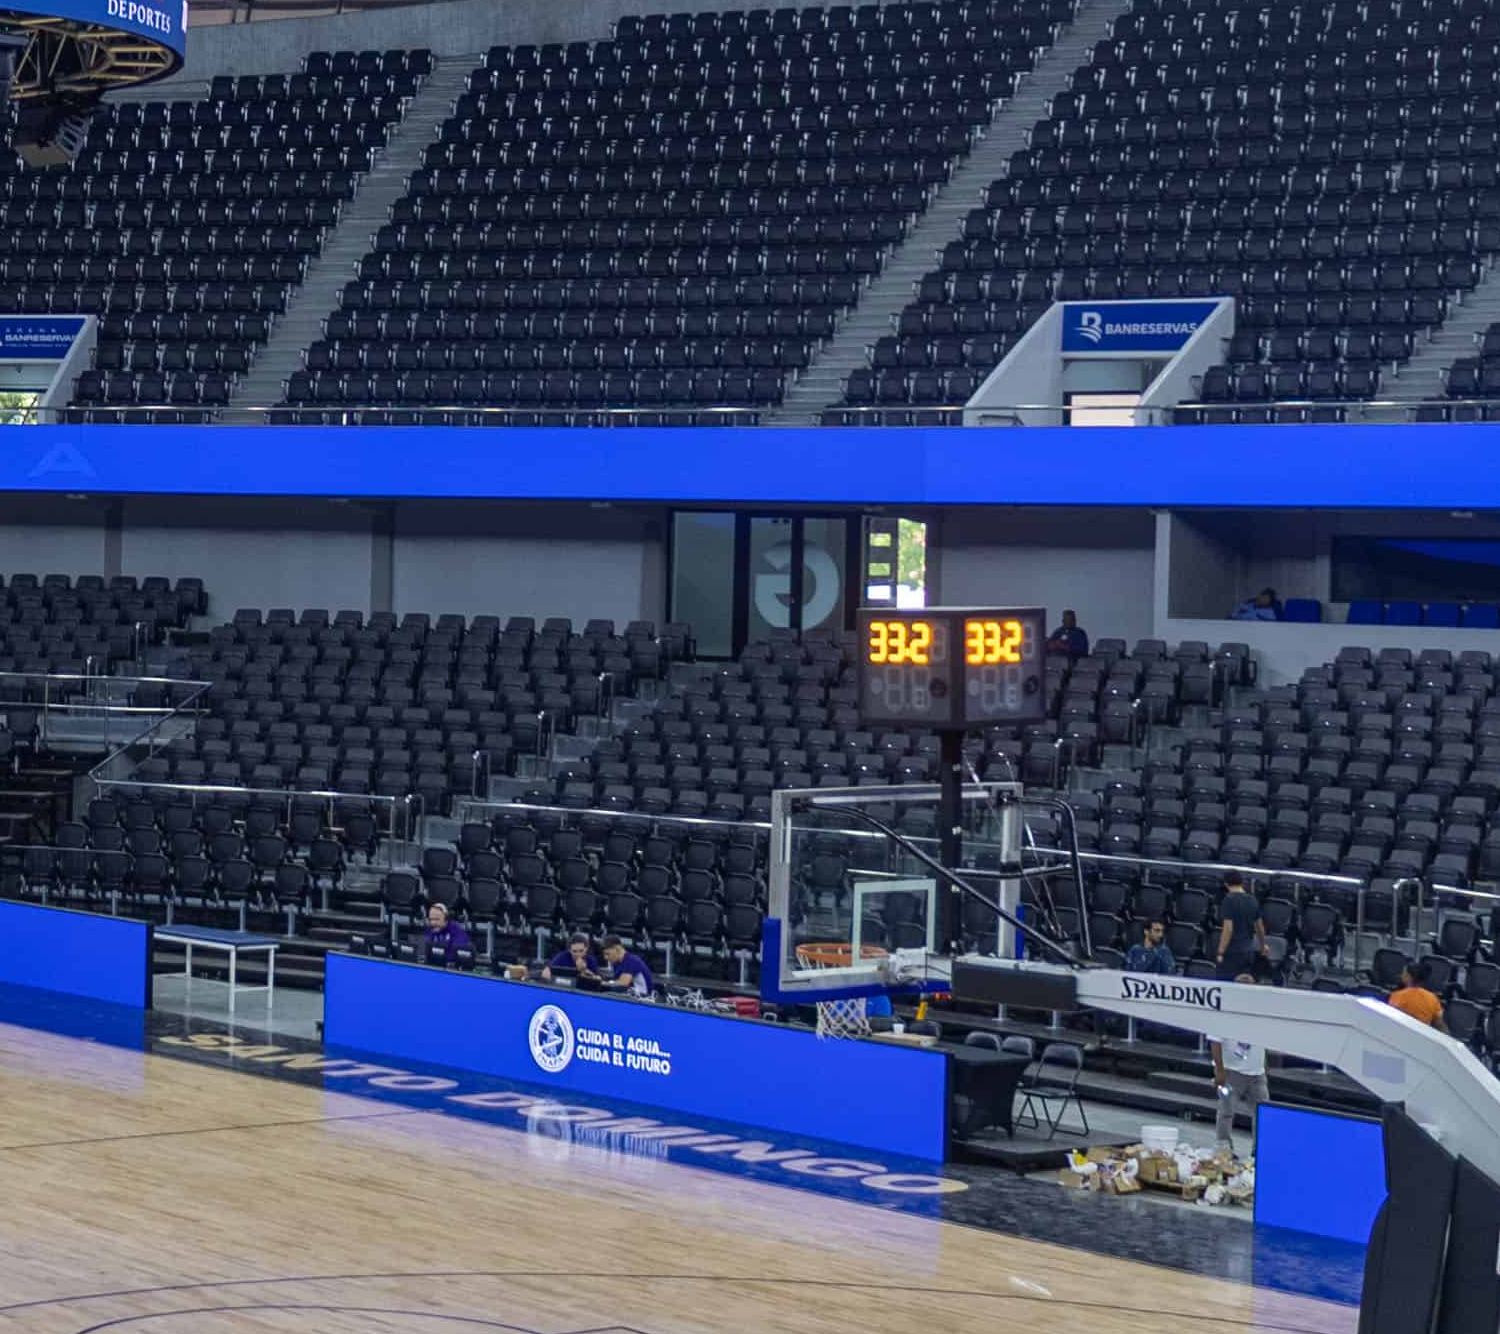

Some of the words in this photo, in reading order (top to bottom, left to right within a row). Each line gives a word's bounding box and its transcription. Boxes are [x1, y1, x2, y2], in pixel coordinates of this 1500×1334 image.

[1121, 976, 1223, 1012] SPALDING
[576, 1027, 611, 1048] CUIDA
[613, 1033, 625, 1051] EL
[156, 1033, 460, 1090] SANTO
[576, 1044, 610, 1065] CUIDA
[612, 1050, 625, 1067] EL
[626, 1053, 672, 1076] FUTURO
[445, 1090, 970, 1193] DOMINGO
